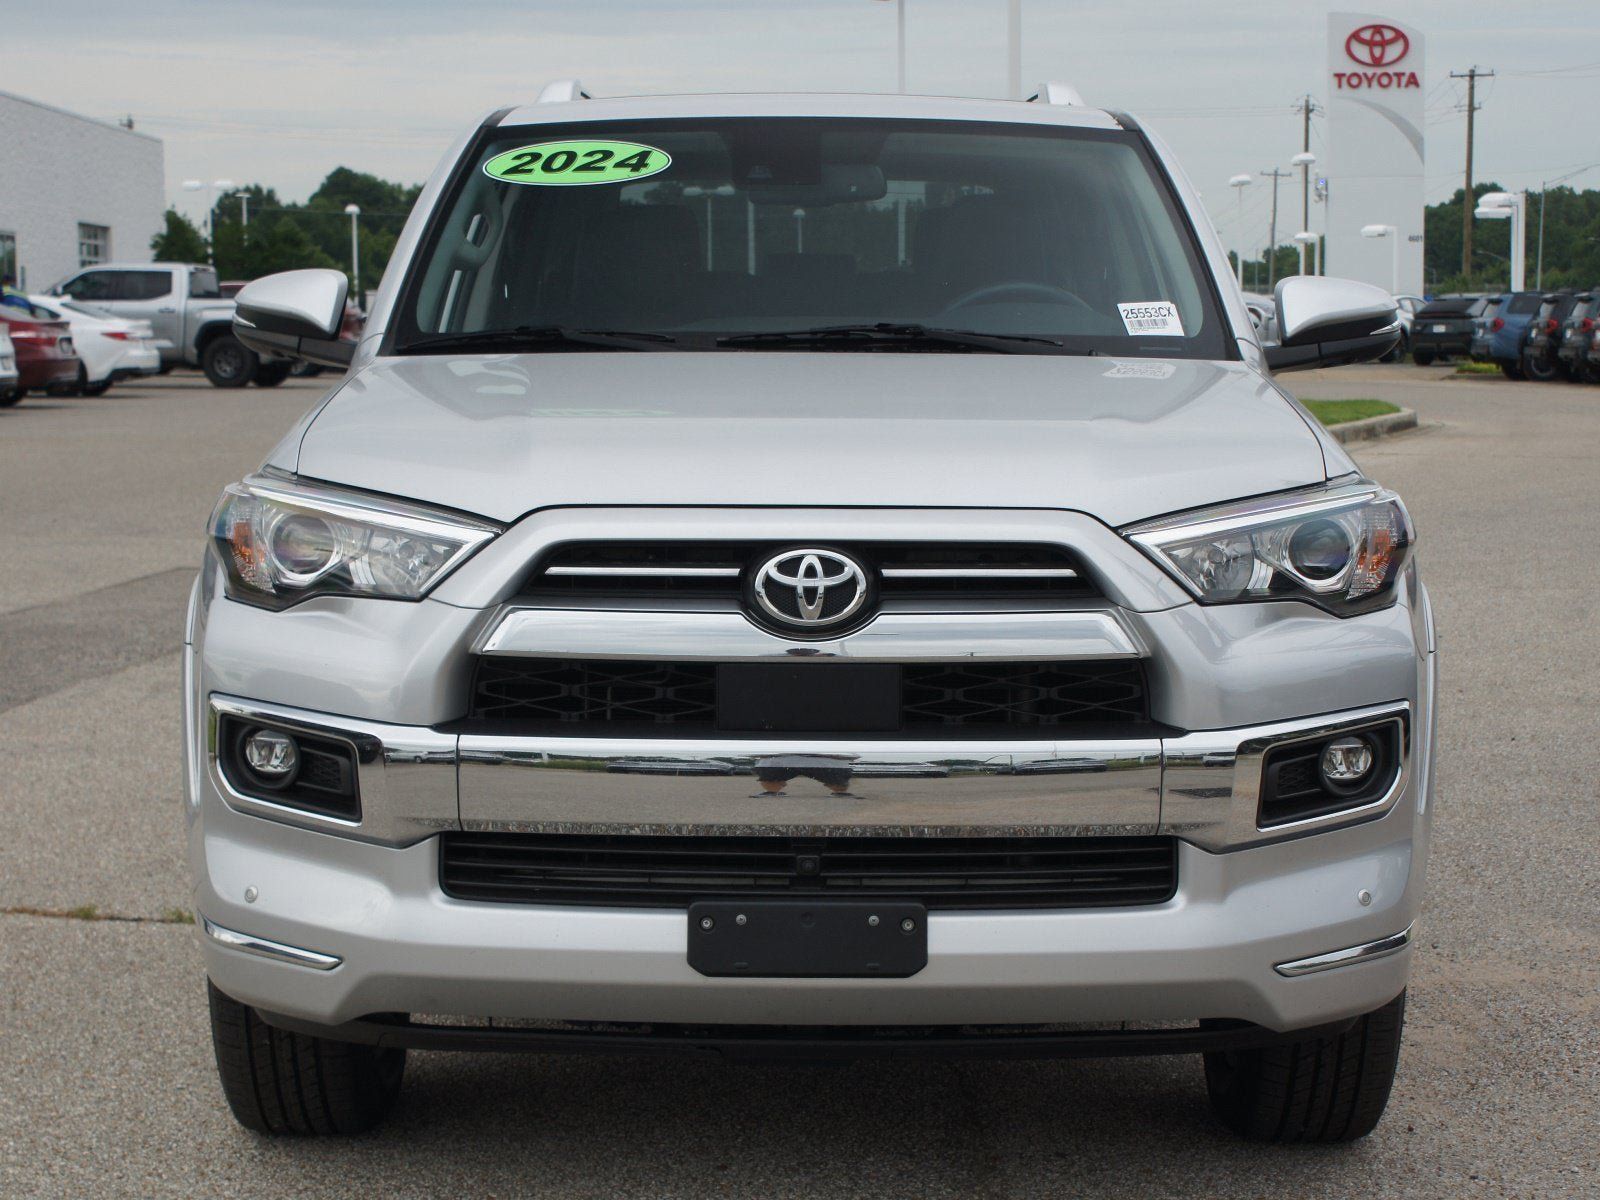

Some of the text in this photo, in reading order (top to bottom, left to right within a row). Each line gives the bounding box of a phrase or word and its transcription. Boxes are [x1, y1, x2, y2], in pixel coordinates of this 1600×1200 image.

[1333, 72, 1420, 89] TOYOTA
[501, 150, 653, 175] 2024
[1122, 306, 1175, 320] 25553CX
